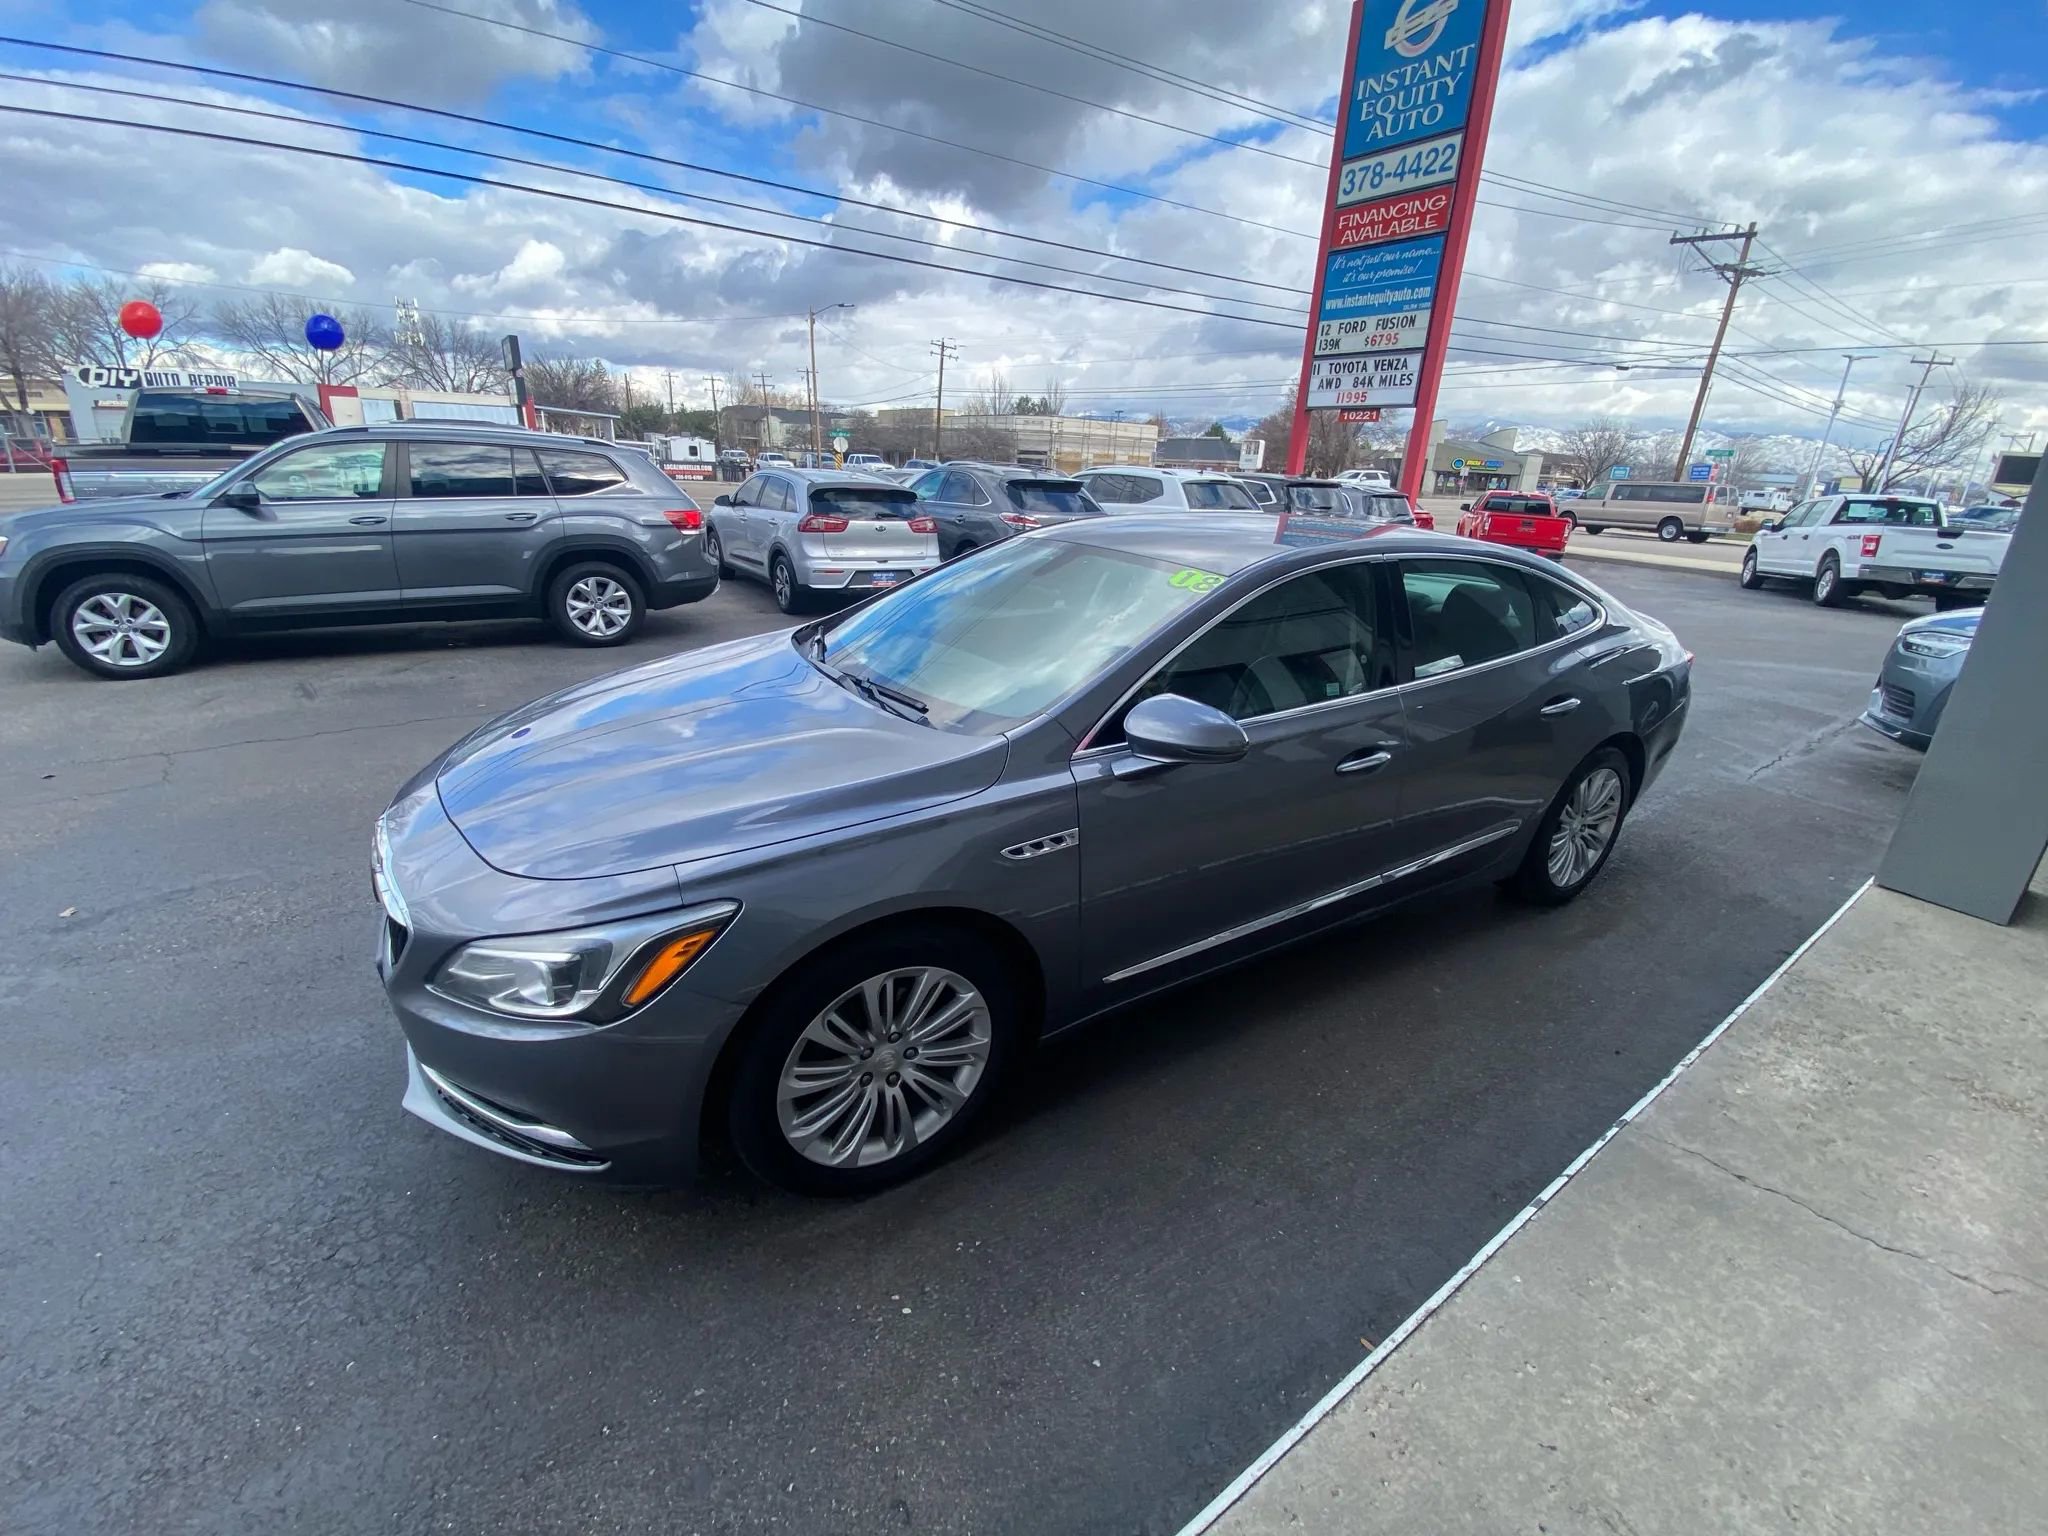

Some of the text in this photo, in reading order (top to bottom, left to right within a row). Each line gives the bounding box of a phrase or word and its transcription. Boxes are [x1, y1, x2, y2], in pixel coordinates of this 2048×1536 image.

[1357, 44, 1475, 101] INSTANT
[1360, 72, 1462, 122] EQUITY
[1365, 103, 1444, 142] AUTO
[1342, 143, 1456, 196] 378-4422
[1339, 195, 1447, 229] FINANCING
[1341, 213, 1438, 244] AVAILABLE
[1332, 254, 1346, 271] It's
[1347, 255, 1364, 268] not
[1362, 251, 1383, 269] just
[1383, 252, 1400, 263] our
[1342, 260, 1423, 283] it's our promise!
[1325, 286, 1431, 310] www.instantequityauto.com
[1320, 314, 1417, 336] 12 FORD FUSION
[1318, 332, 1399, 351] 139K $6795
[1313, 357, 1408, 375] 11 TOYOTA VENZA
[88, 367, 139, 388] DIY
[1318, 373, 1414, 390] AWD 84K MILES
[1336, 391, 1367, 404] 11995
[1343, 410, 1377, 420] 10221
